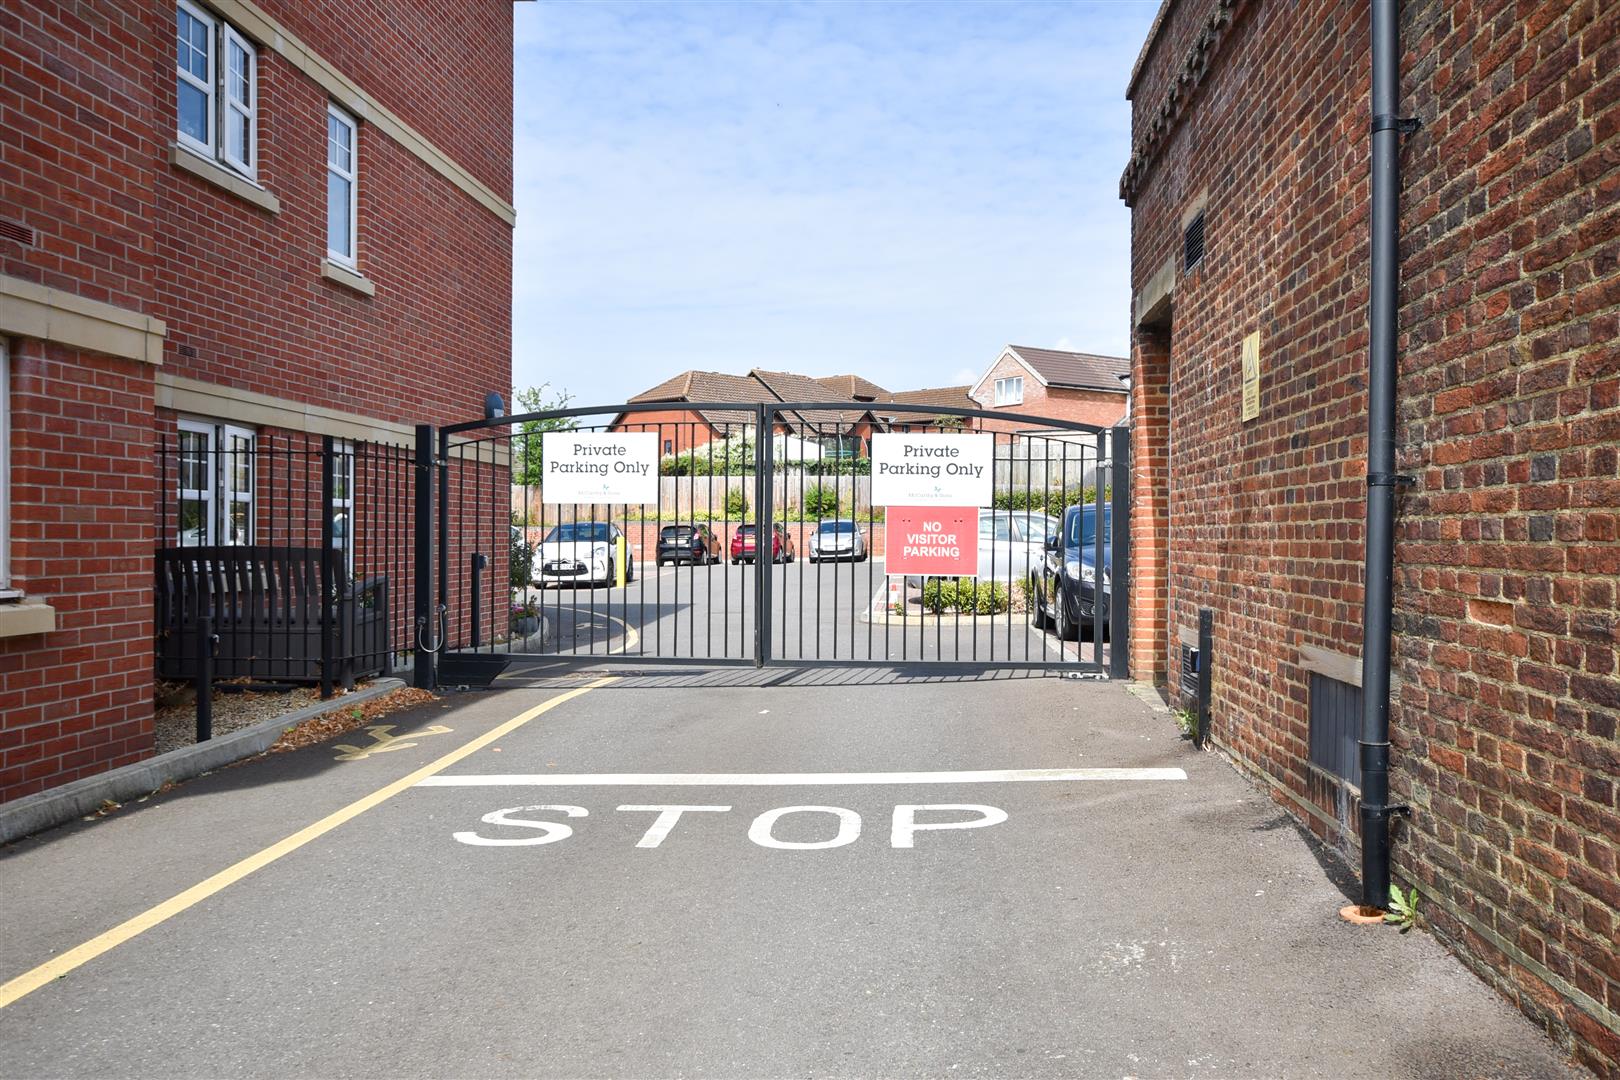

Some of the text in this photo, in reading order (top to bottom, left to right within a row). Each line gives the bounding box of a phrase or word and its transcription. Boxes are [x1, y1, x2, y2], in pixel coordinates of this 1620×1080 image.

[573, 444, 627, 456] Private
[903, 444, 960, 458] Private
[550, 461, 650, 477] Parking Only
[879, 462, 984, 479] Parking Only
[923, 521, 942, 532] NO
[907, 534, 957, 545] VISITOR
[903, 546, 960, 558] PARKING
[452, 804, 1009, 850] STOP
